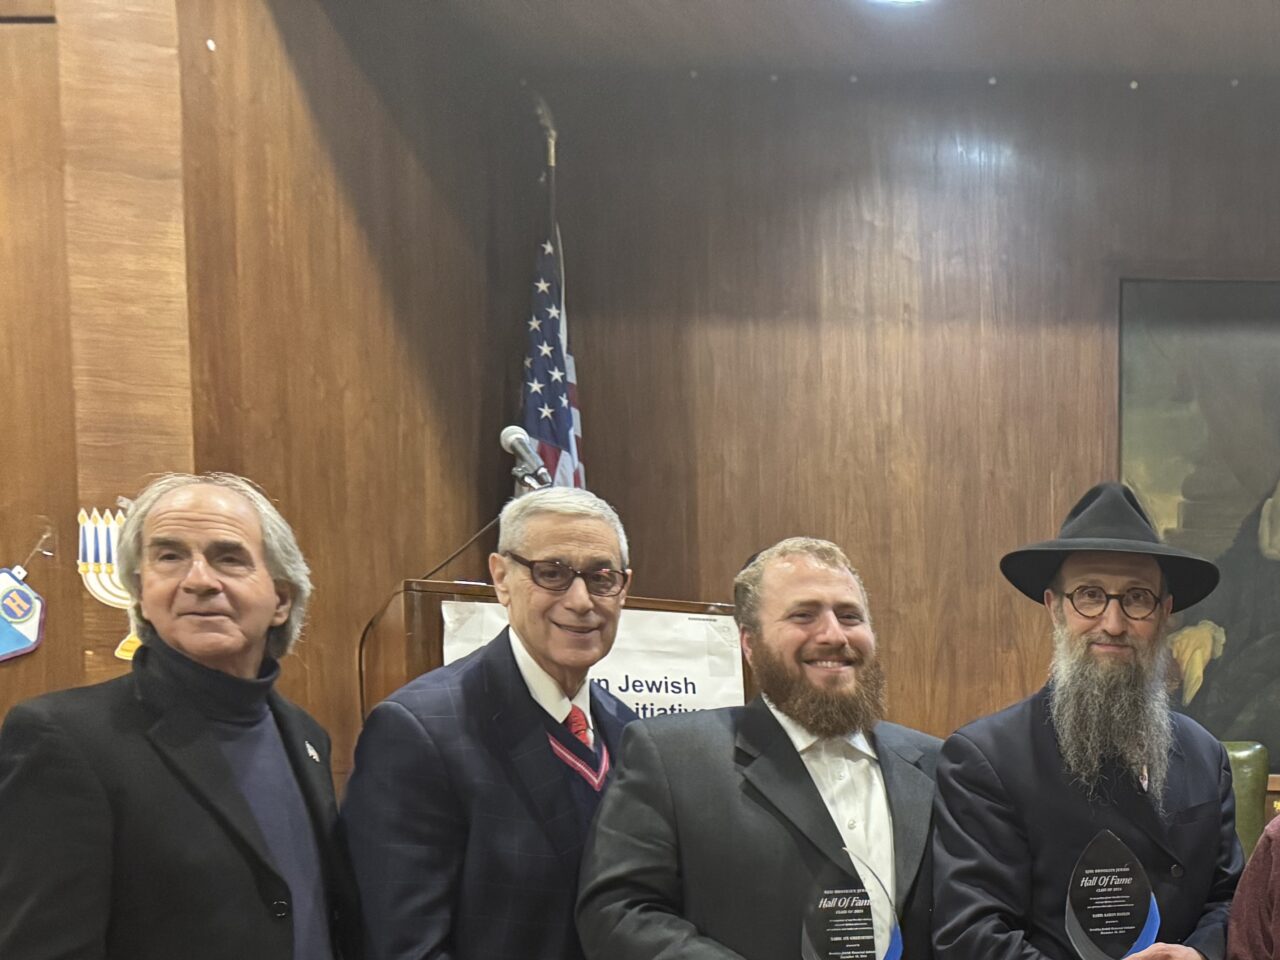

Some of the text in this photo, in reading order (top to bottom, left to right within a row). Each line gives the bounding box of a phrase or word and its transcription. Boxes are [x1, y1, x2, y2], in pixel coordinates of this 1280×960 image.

[618, 674, 697, 694] Jewish
[1080, 875, 1133, 888] Hall Of Fame
[818, 897, 838, 909] Hall
[838, 896, 852, 909] Of
